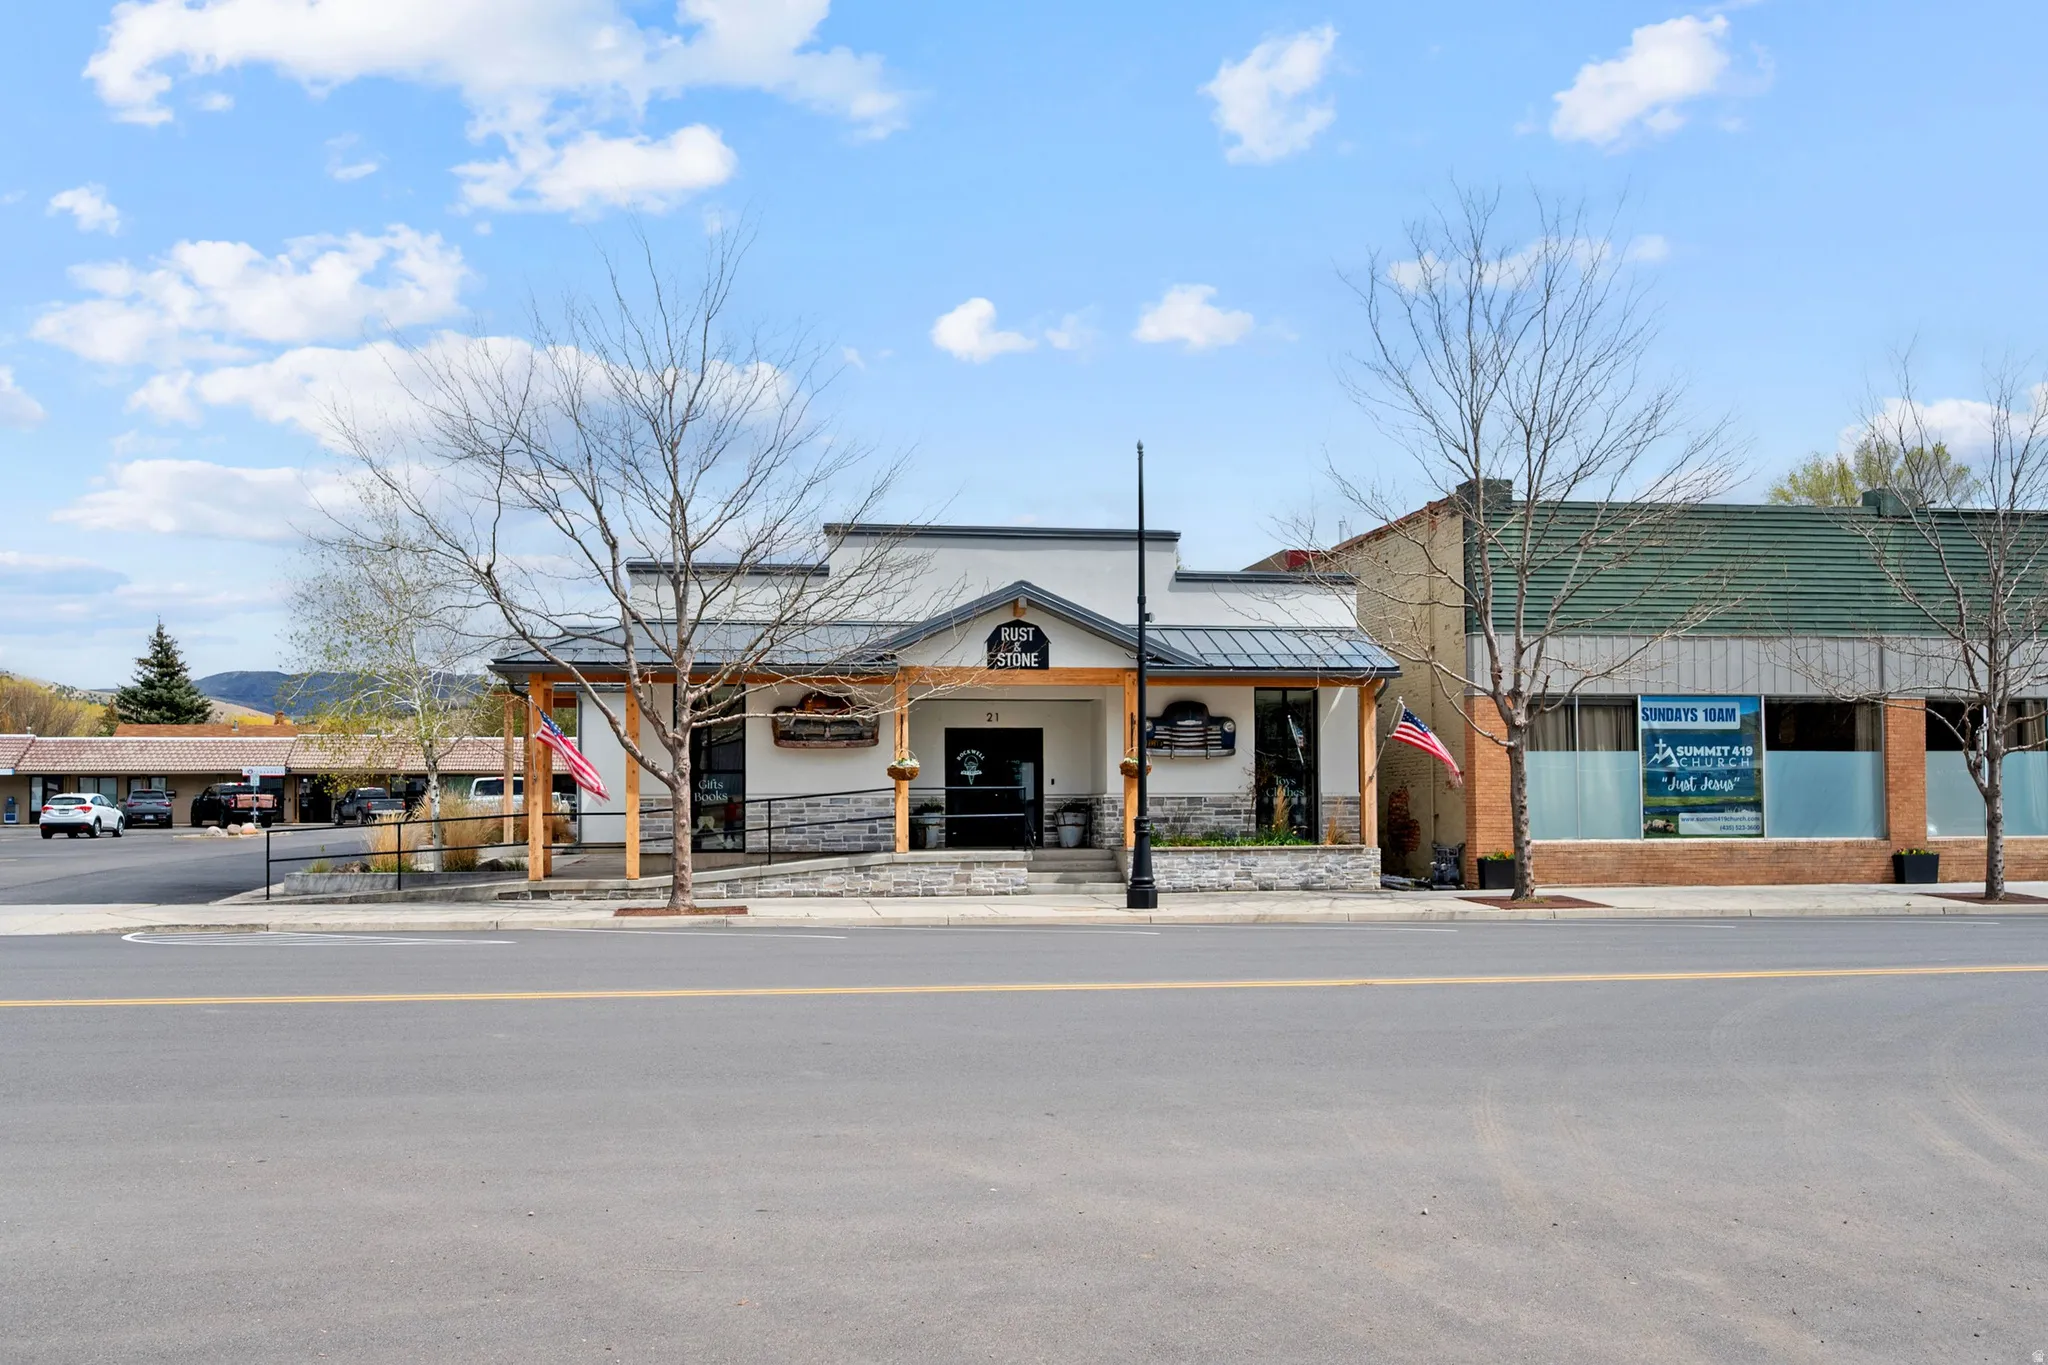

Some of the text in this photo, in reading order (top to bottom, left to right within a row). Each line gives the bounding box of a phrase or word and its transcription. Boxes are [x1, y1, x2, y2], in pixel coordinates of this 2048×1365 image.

[1001, 627, 1035, 641] RUST
[1014, 642, 1021, 652] &
[997, 652, 1039, 667] STONE
[986, 712, 999, 722] 21
[1641, 707, 1736, 722] SUNDAYS 10AM
[956, 749, 985, 761] ROCKWELL
[1676, 746, 1753, 757] SUMMIT 419
[1679, 758, 1750, 767] CHURCH
[698, 779, 724, 790] Gifts
[1273, 775, 1297, 788] Toys
[694, 790, 728, 802] Books
[1265, 786, 1305, 797] Clthes
